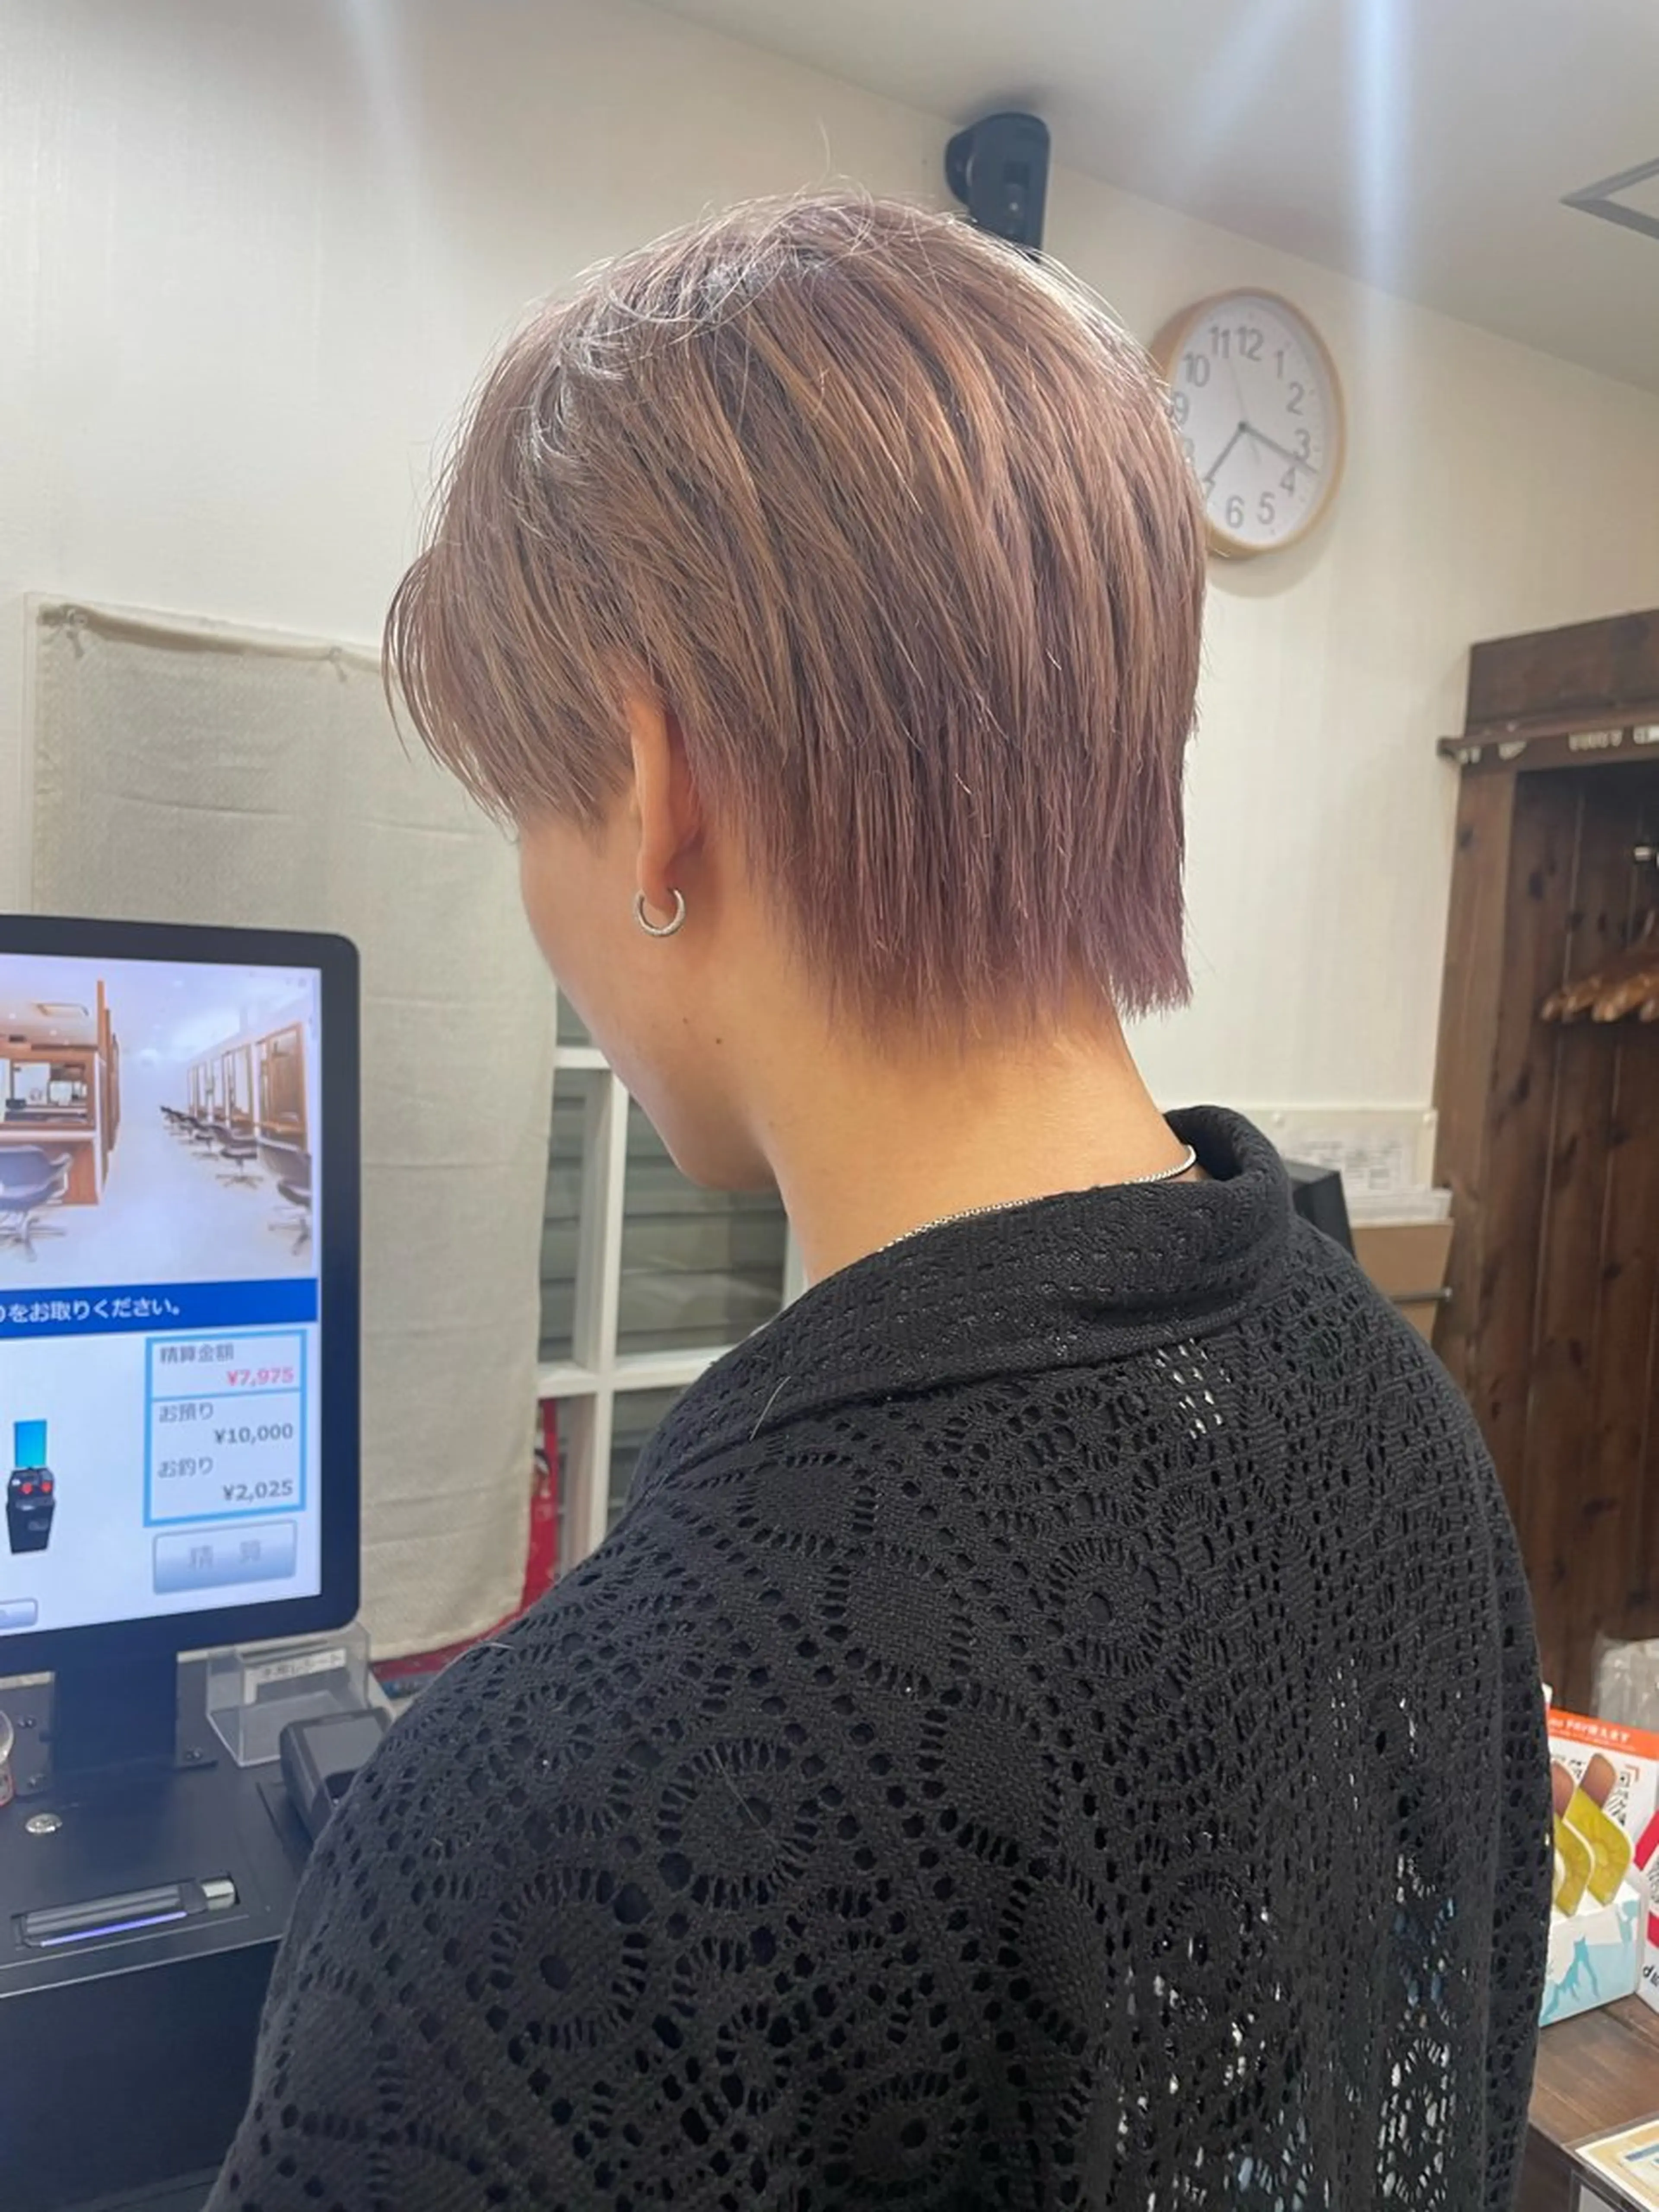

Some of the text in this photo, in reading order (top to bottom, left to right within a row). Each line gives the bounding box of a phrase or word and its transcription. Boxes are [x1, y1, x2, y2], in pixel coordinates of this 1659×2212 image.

[1210, 326, 1230, 359] 11
[1237, 326, 1263, 361] 12
[1184, 352, 1210, 387] 10
[1274, 350, 1284, 378] 1
[1171, 391, 1189, 424] 9
[1286, 381, 1305, 415] 2
[1294, 429, 1311, 462] 3
[1279, 466, 1295, 496] 4
[1225, 495, 1244, 528] 6
[1257, 492, 1275, 524] 5
[227, 1367, 294, 1387] ¥7,975
[214, 1423, 294, 1445] ¥10,000
[223, 1478, 294, 1502] ¥2,025
